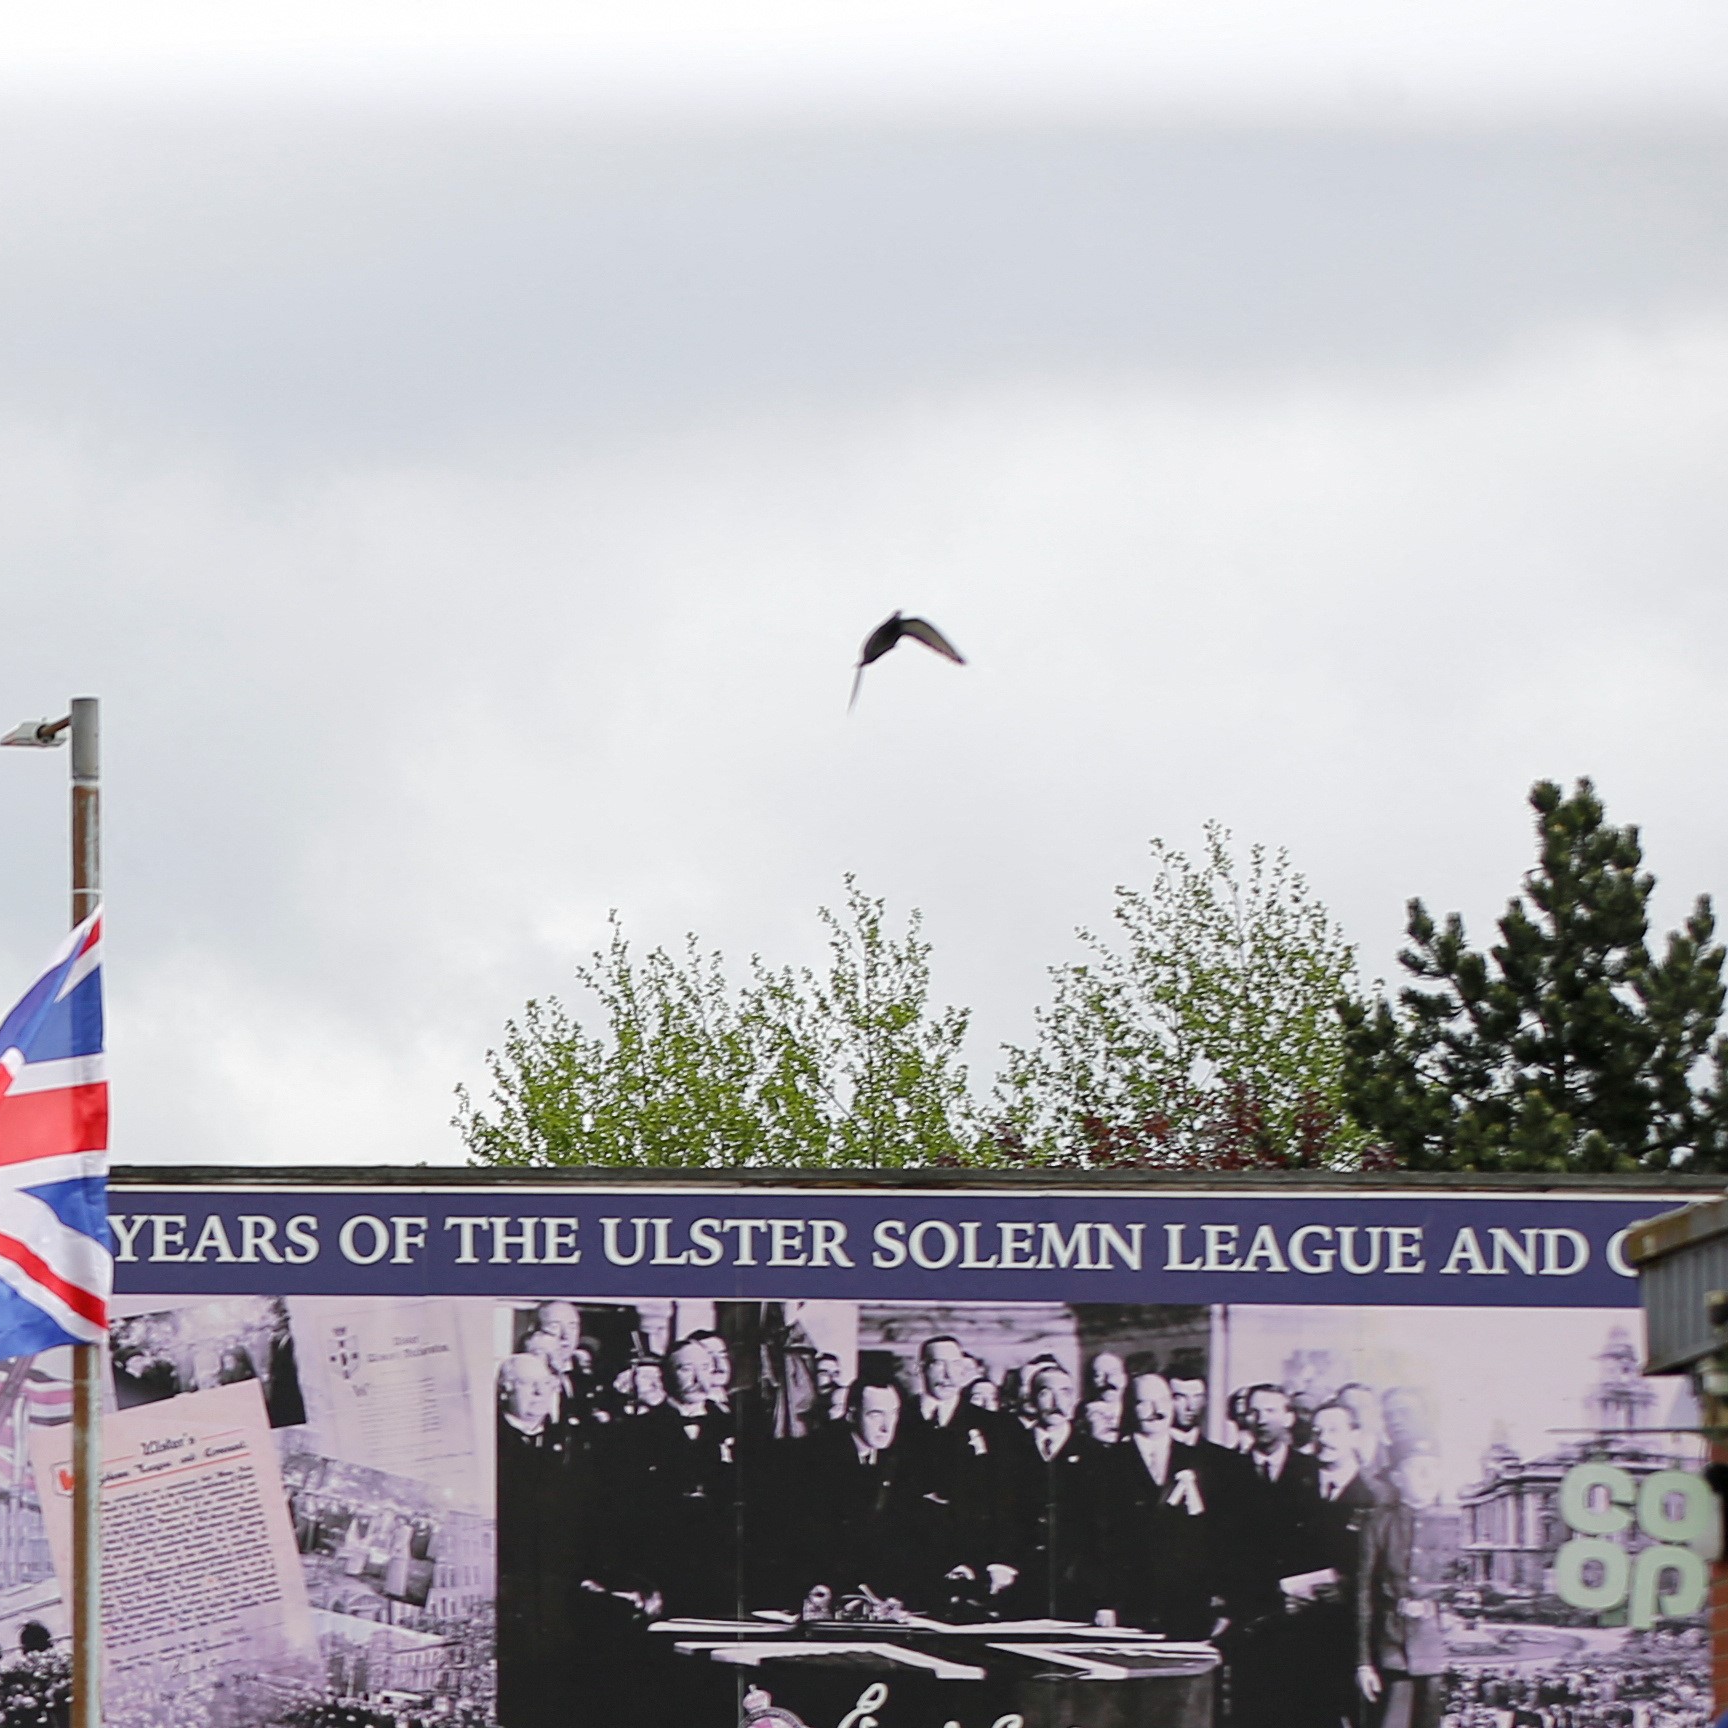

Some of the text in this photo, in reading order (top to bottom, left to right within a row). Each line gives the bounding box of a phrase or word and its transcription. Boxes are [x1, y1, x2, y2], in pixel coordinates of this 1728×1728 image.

[108, 1214, 319, 1264] YEARS
[339, 1215, 428, 1265] OF
[443, 1216, 582, 1264] THE
[598, 1217, 856, 1268] ULSTER
[872, 1220, 1147, 1271] SOLEMN
[1162, 1224, 1426, 1274] LEAGUE
[1439, 1227, 1590, 1275] AND
